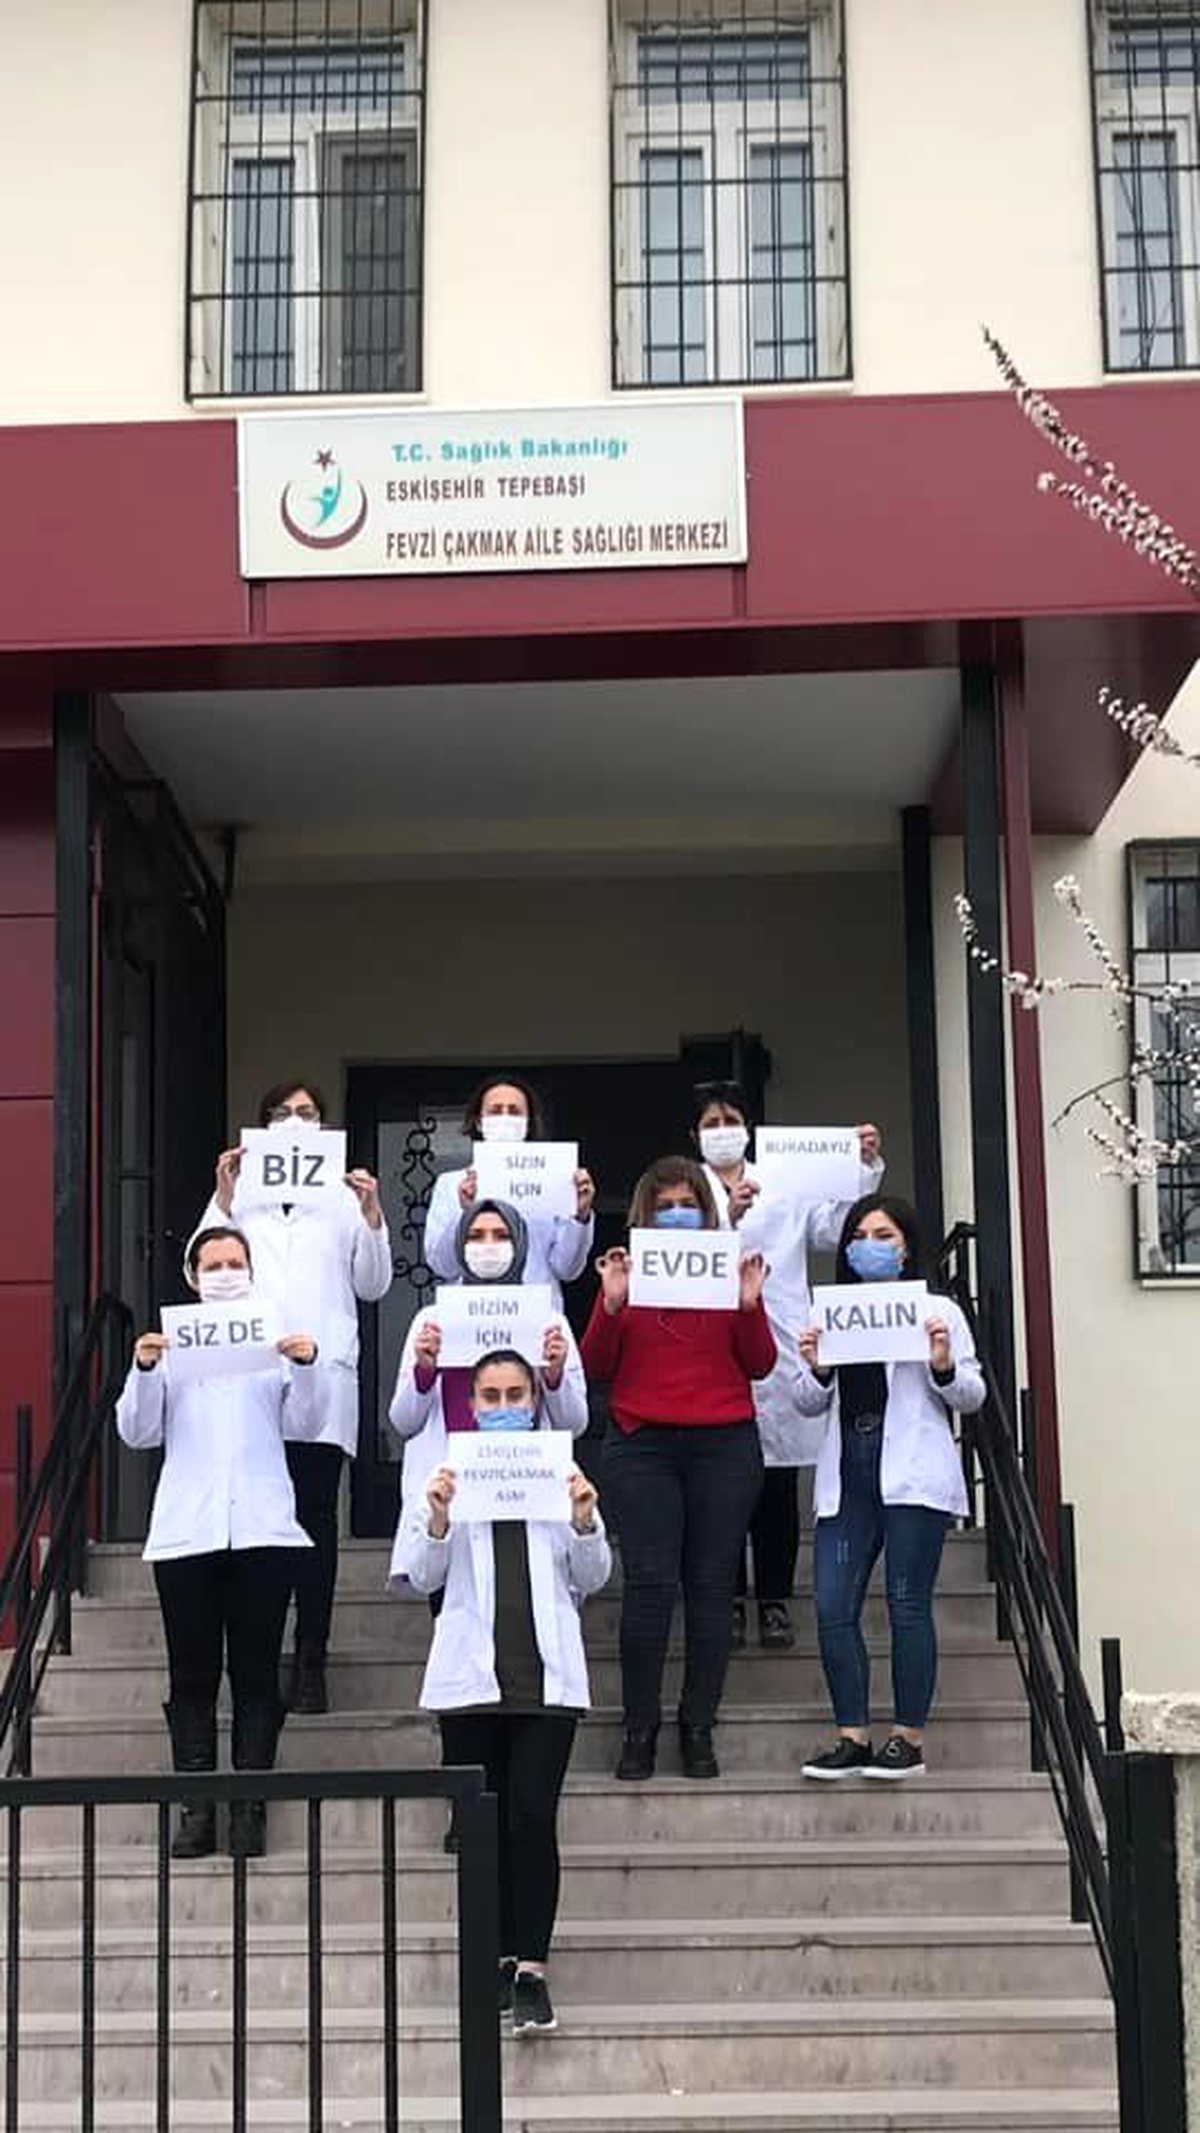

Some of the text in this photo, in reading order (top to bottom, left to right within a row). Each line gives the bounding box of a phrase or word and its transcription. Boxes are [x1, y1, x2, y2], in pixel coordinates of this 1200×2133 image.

[391, 436, 627, 464] T.C. Sağlık Bakanlığı
[386, 473, 585, 502] ESKİŞEHİR TEPEBAŞI
[386, 517, 728, 564] FEVZİ ÇAKMAK AİLE SAĞLIĞI MERKEZİ
[262, 1146, 325, 1187] BİZ
[641, 1250, 728, 1278] EVDE
[825, 1302, 918, 1331] KALIN
[177, 1318, 266, 1348] SİZ DE
[476, 1325, 512, 1350] İÇİN
